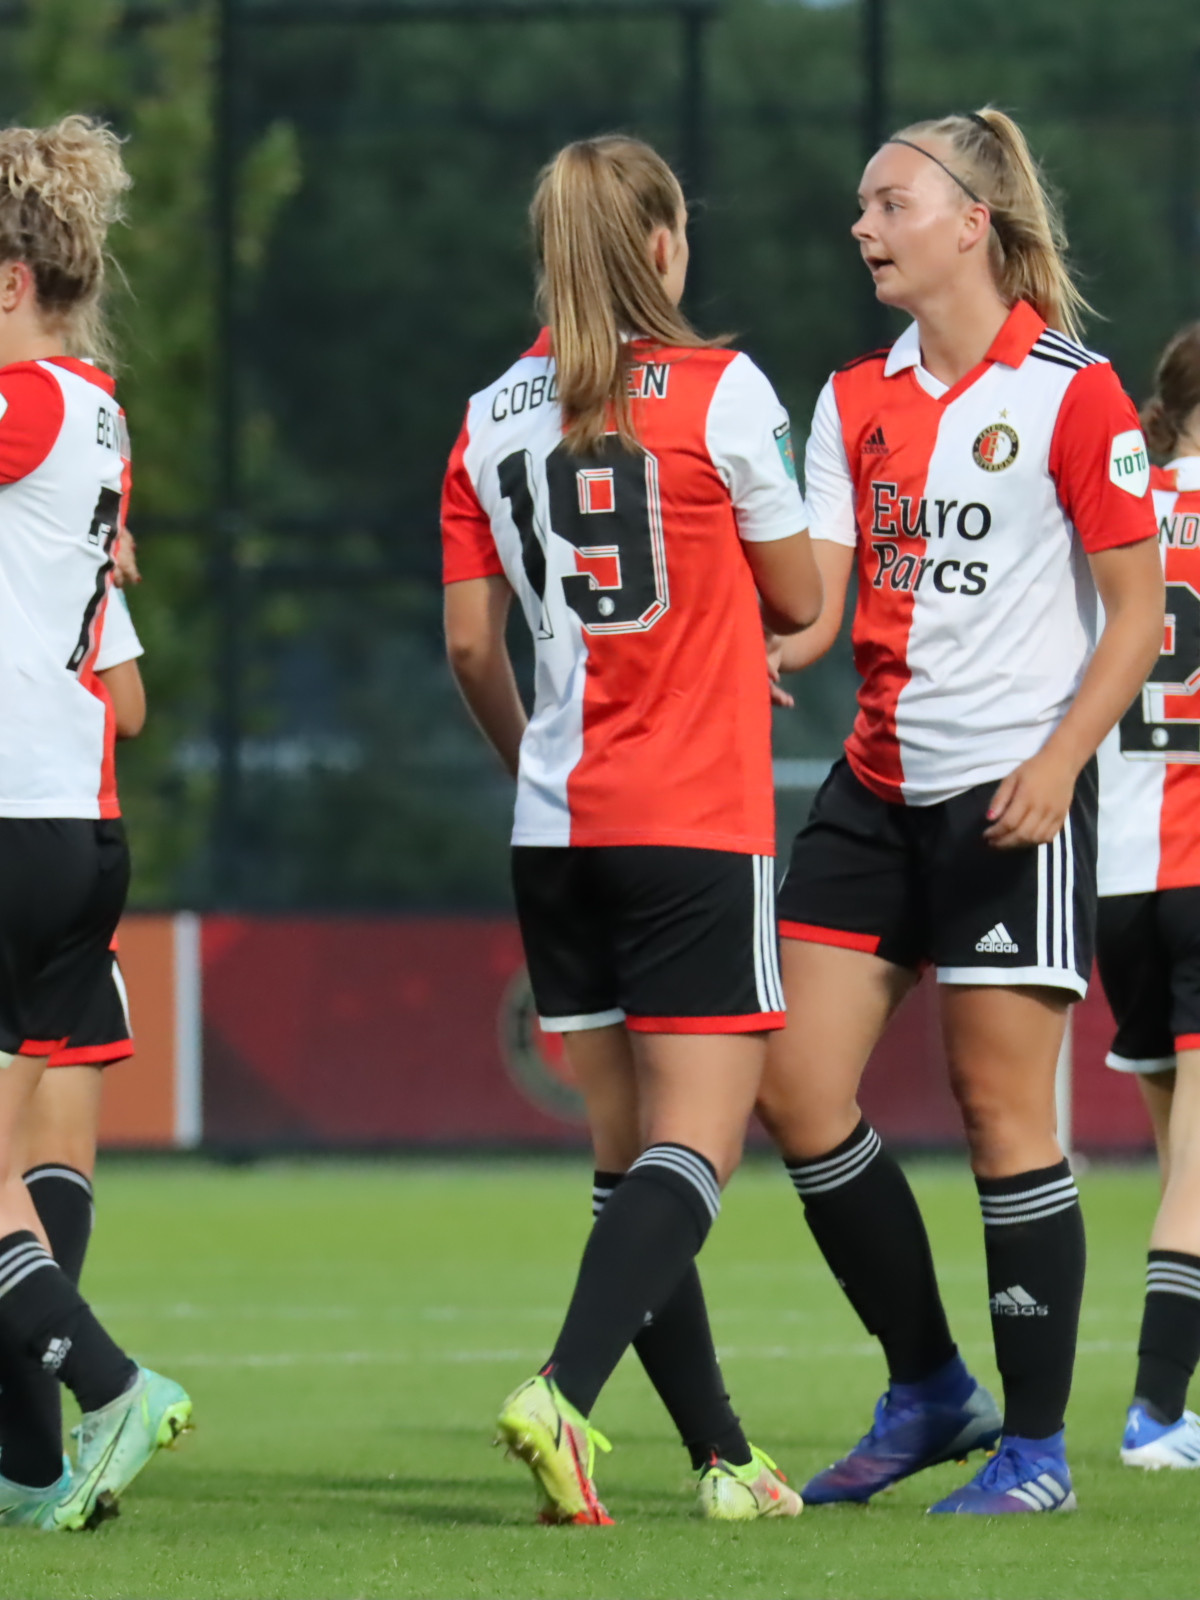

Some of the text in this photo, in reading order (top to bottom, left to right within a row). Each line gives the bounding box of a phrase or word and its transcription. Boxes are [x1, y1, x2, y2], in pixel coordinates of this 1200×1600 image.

[497, 433, 669, 640] 19
[871, 481, 992, 541] Euro
[871, 541, 989, 596] Parcs
[975, 942, 1019, 954] adidas
